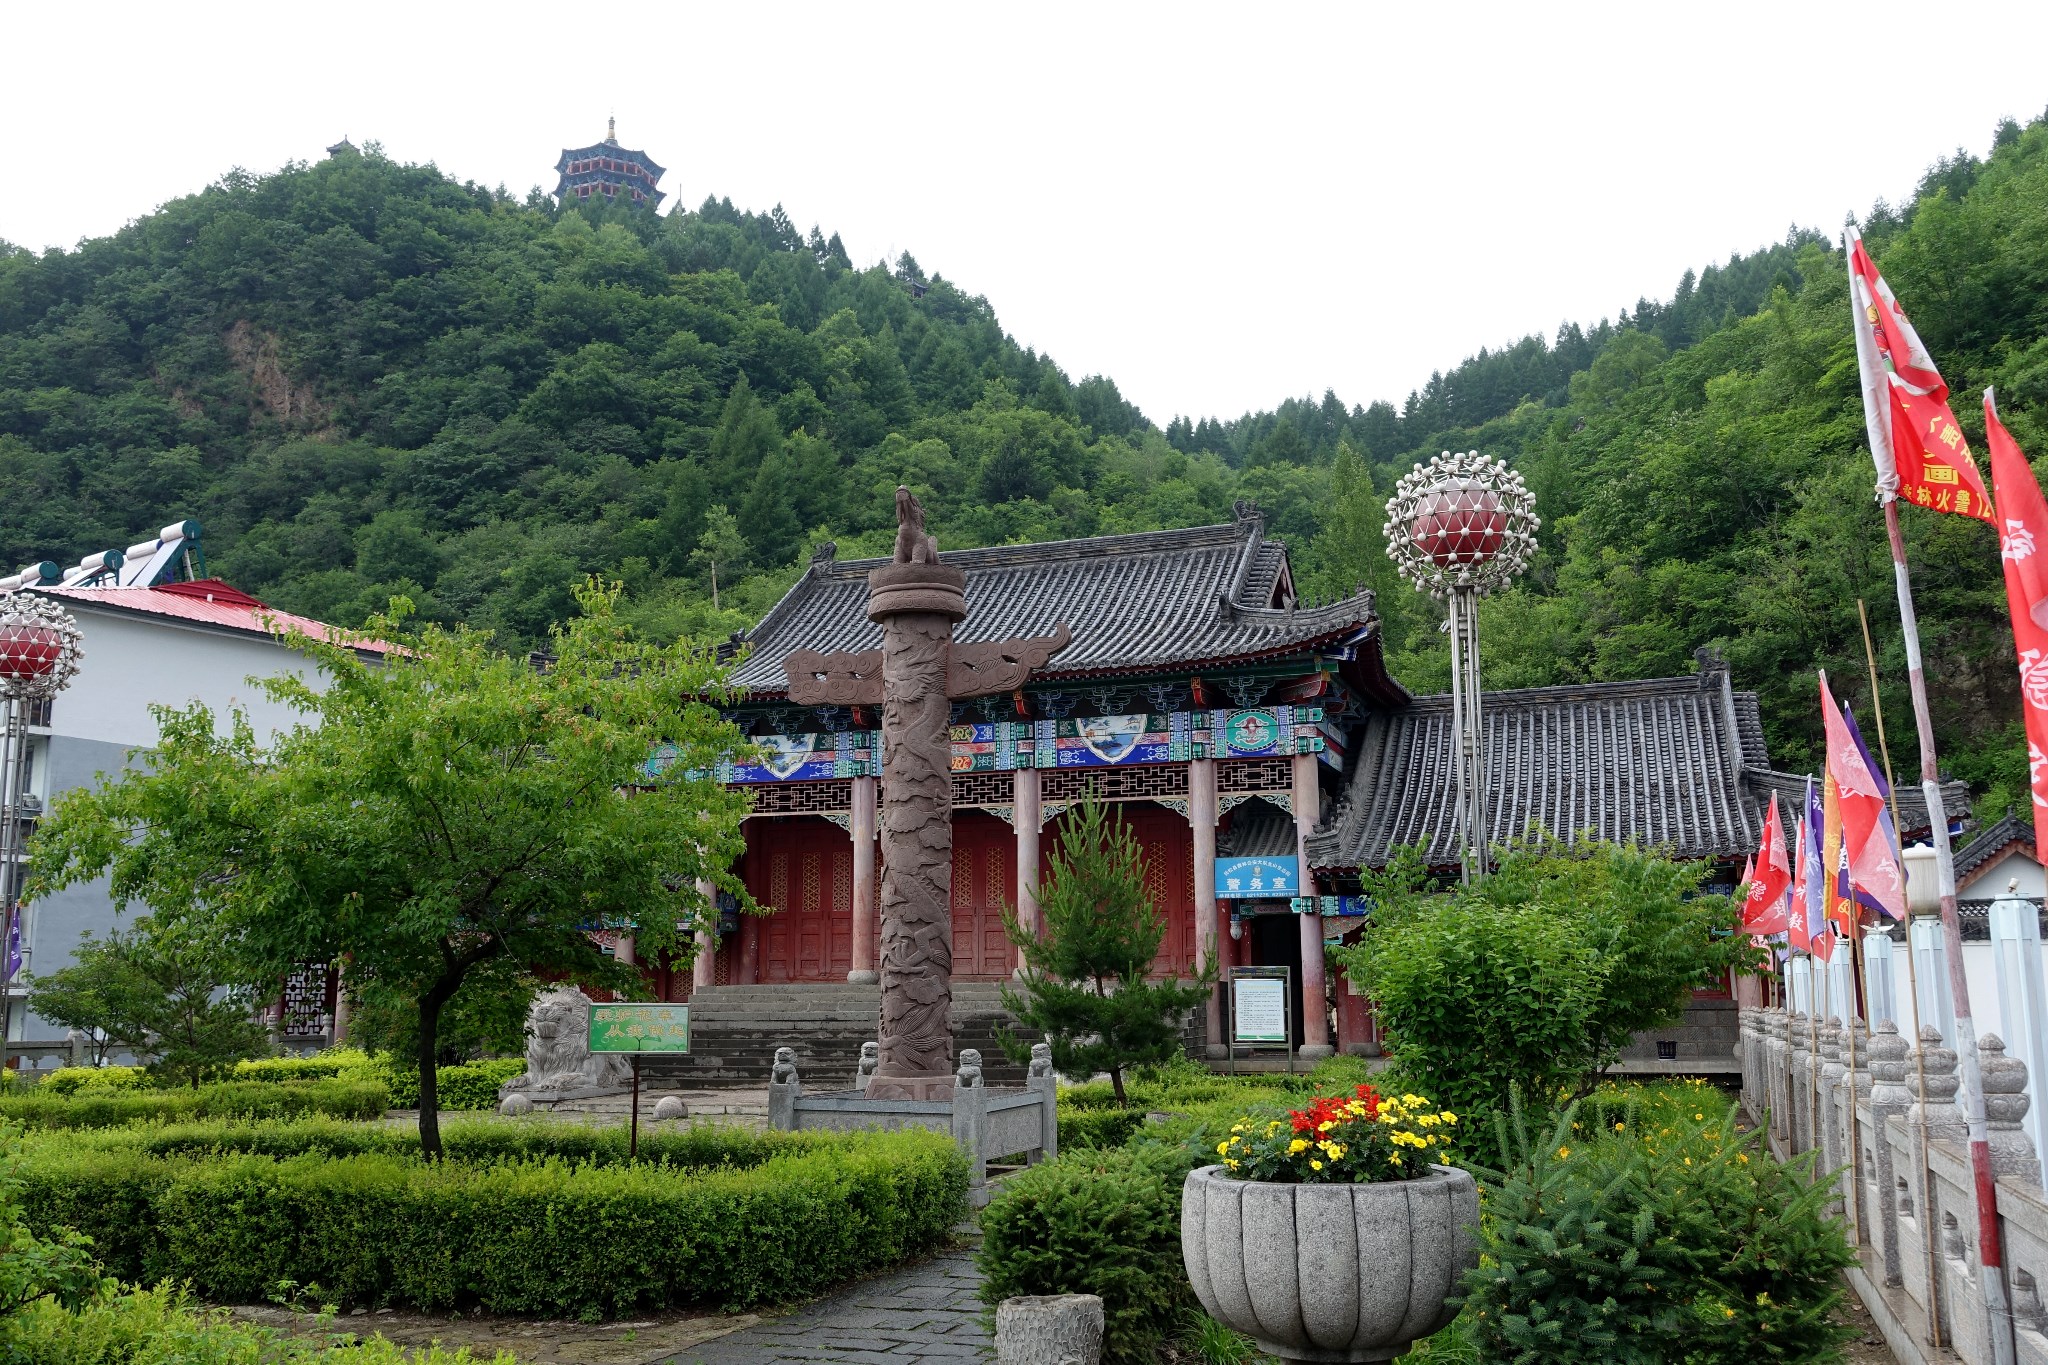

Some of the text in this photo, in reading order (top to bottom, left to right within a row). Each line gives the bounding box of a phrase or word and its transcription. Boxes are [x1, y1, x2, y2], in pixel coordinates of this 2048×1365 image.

[1226, 877, 1286, 890] 警务室
[594, 1008, 672, 1021] 爱护花草
[605, 1024, 685, 1038] 从我做起
